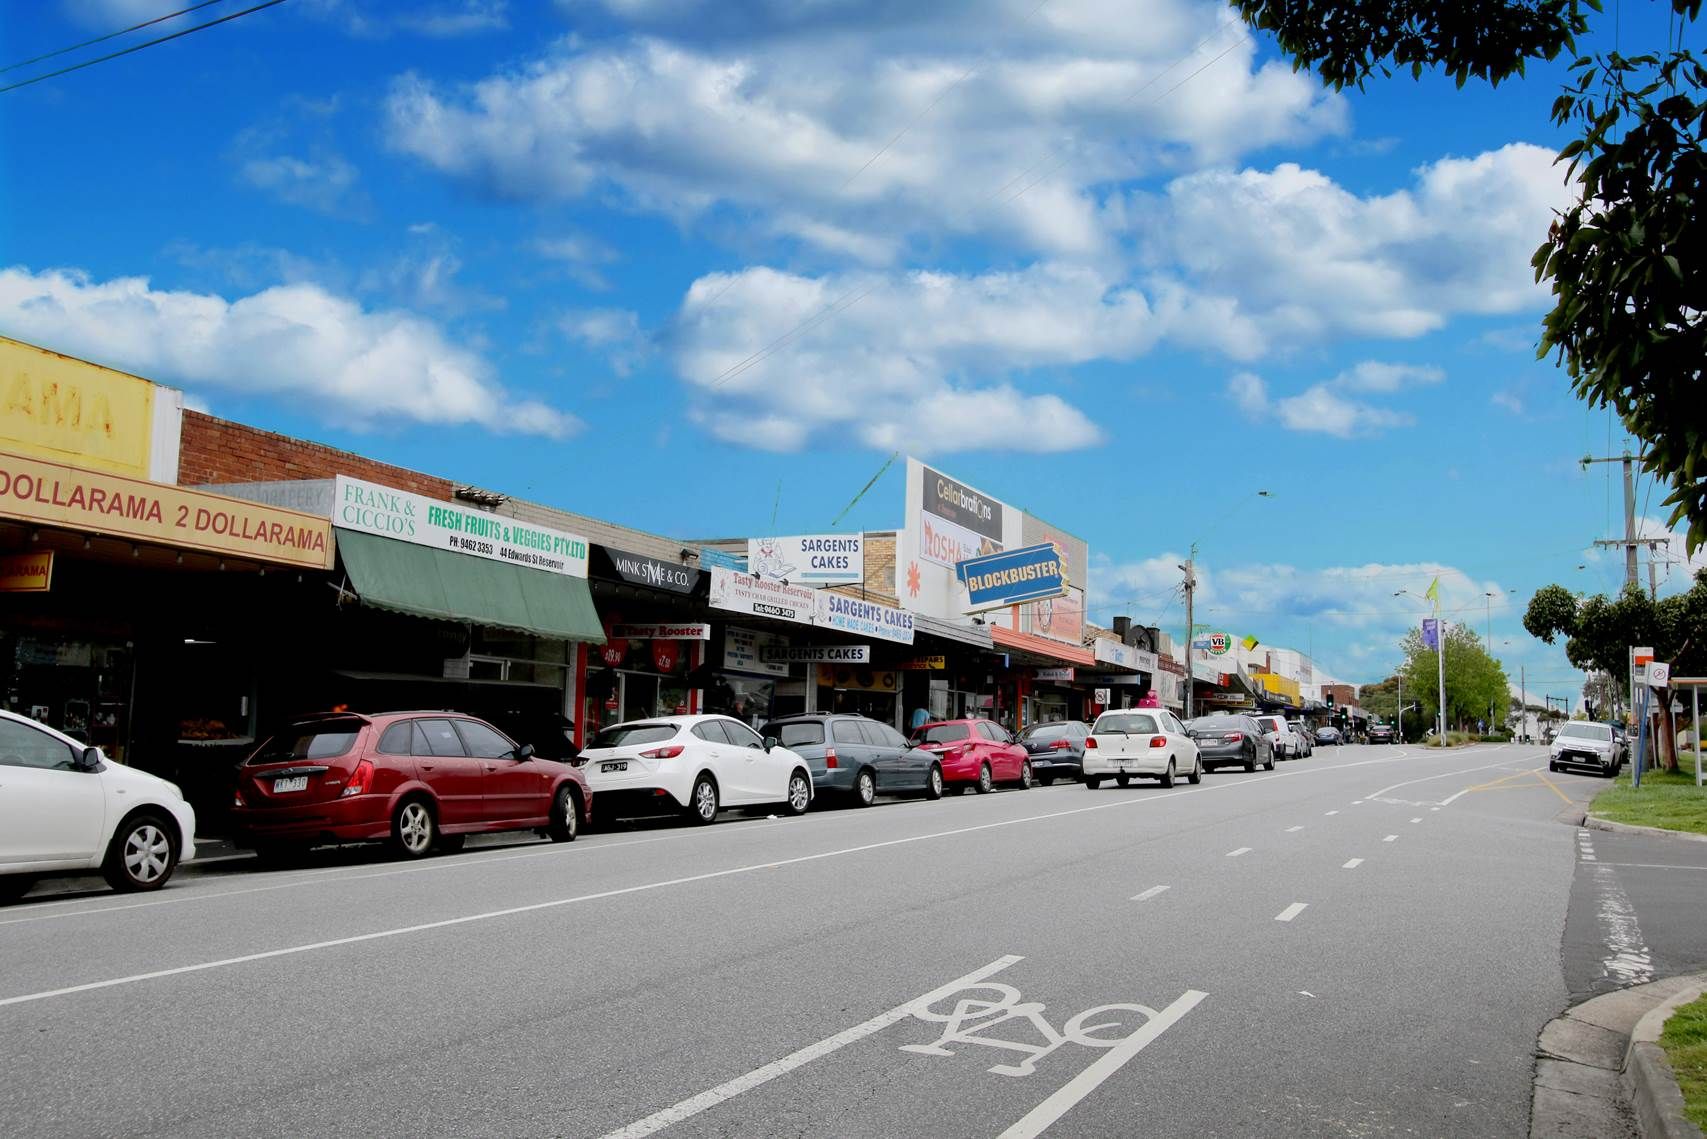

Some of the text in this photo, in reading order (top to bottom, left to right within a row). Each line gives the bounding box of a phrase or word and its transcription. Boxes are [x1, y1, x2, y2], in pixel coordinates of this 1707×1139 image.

[0, 469, 325, 553] DOLLARAMA 2 DOLLARAMA
[344, 484, 416, 517] FRANK &
[343, 505, 416, 537] CICCIO'S
[428, 505, 462, 533] FRESH
[464, 514, 501, 541] FRUITS
[503, 527, 510, 543] &
[512, 525, 552, 553] VEGGIES
[460, 537, 476, 551] 9462
[477, 541, 493, 555] 3353
[499, 547, 507, 558] 44
[508, 547, 532, 564] Edwards
[532, 552, 538, 564] St
[539, 554, 564, 570] Reservoir
[801, 539, 859, 553] SARGENTS
[616, 557, 640, 576] MINK
[667, 570, 673, 583] &
[674, 571, 689, 586] CO.
[811, 555, 849, 569] CAKES
[968, 561, 1058, 592] BLOCKBUSTER
[734, 572, 812, 599] Tasty Rooster Reservoir
[829, 595, 912, 629] SARGENTS CAKES
[625, 626, 703, 637] Tasty Rooster
[1212, 638, 1224, 646] VB
[767, 647, 864, 660] SARGENTS CAKES
